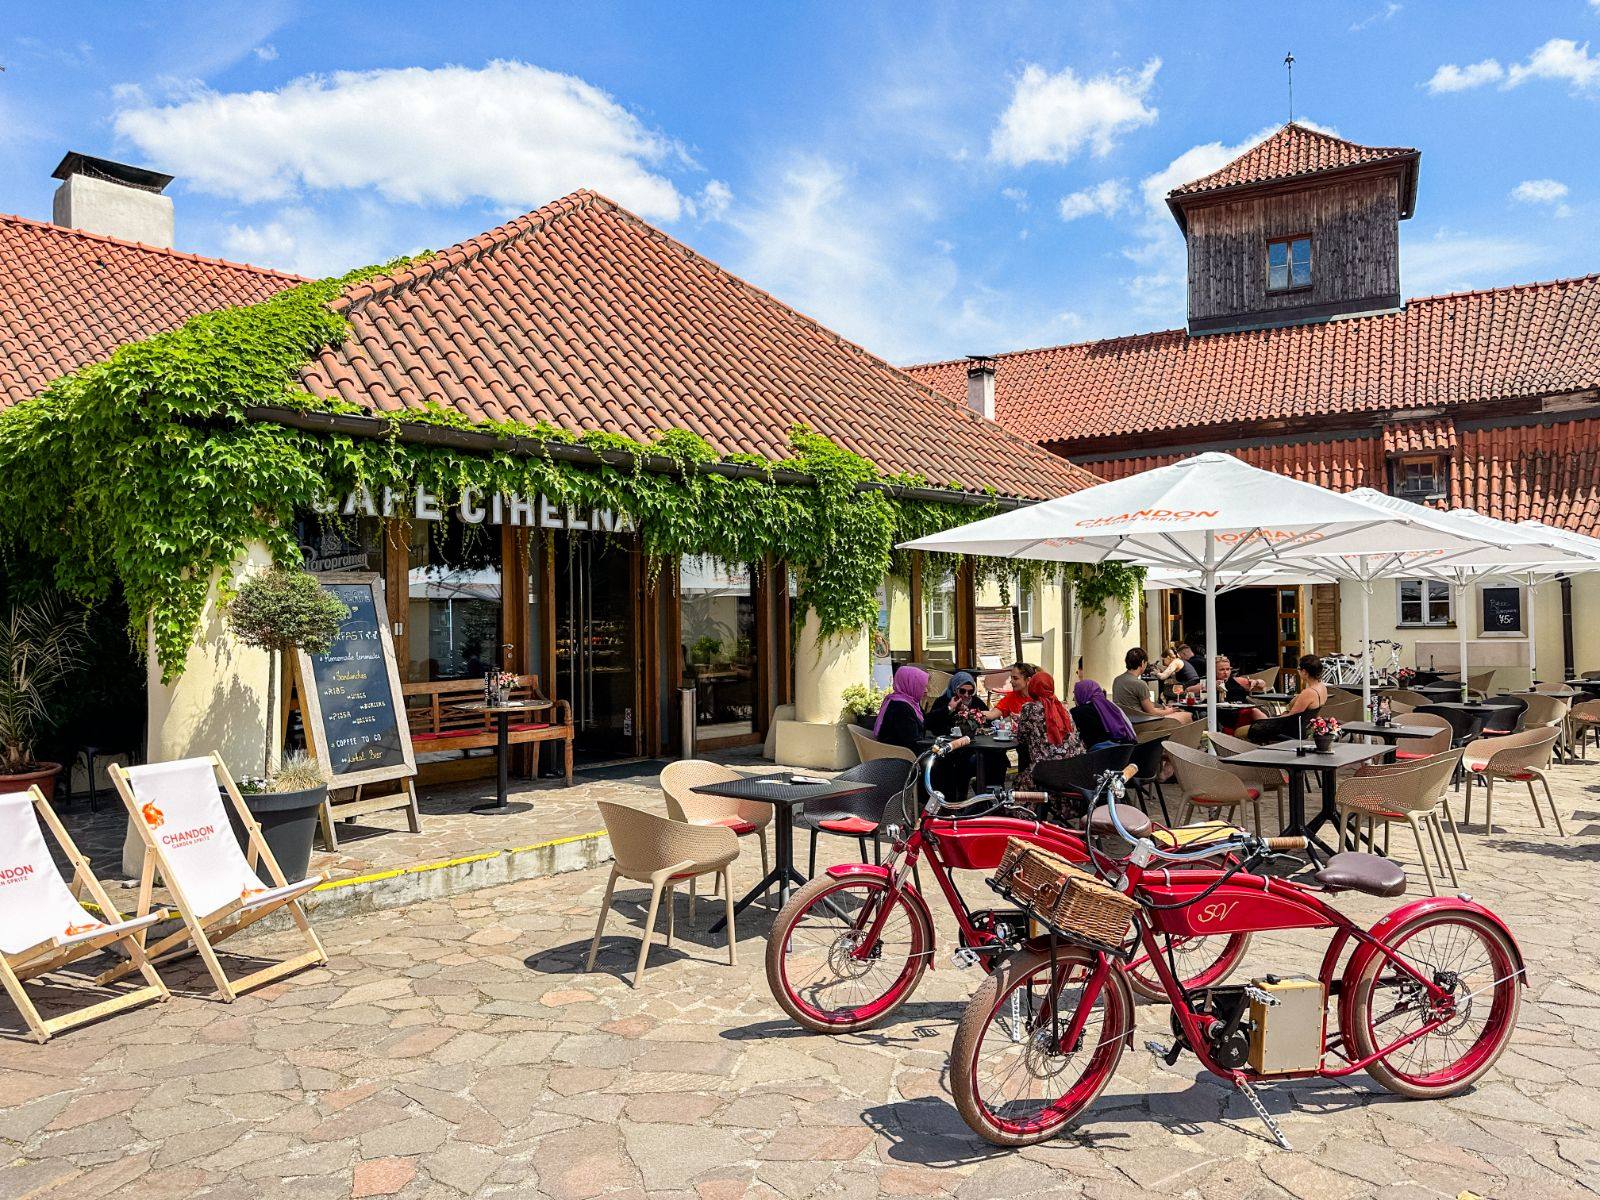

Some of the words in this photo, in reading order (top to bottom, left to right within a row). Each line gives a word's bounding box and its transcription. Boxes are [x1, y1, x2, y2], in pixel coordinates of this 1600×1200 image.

[1075, 509, 1219, 527] CHANDON
[328, 686, 346, 696] RIBS
[336, 737, 357, 748] COFFEE
[361, 735, 370, 743] TO
[373, 733, 382, 742] GO
[162, 825, 214, 845] CHANDON
[0, 864, 34, 879] NDON
